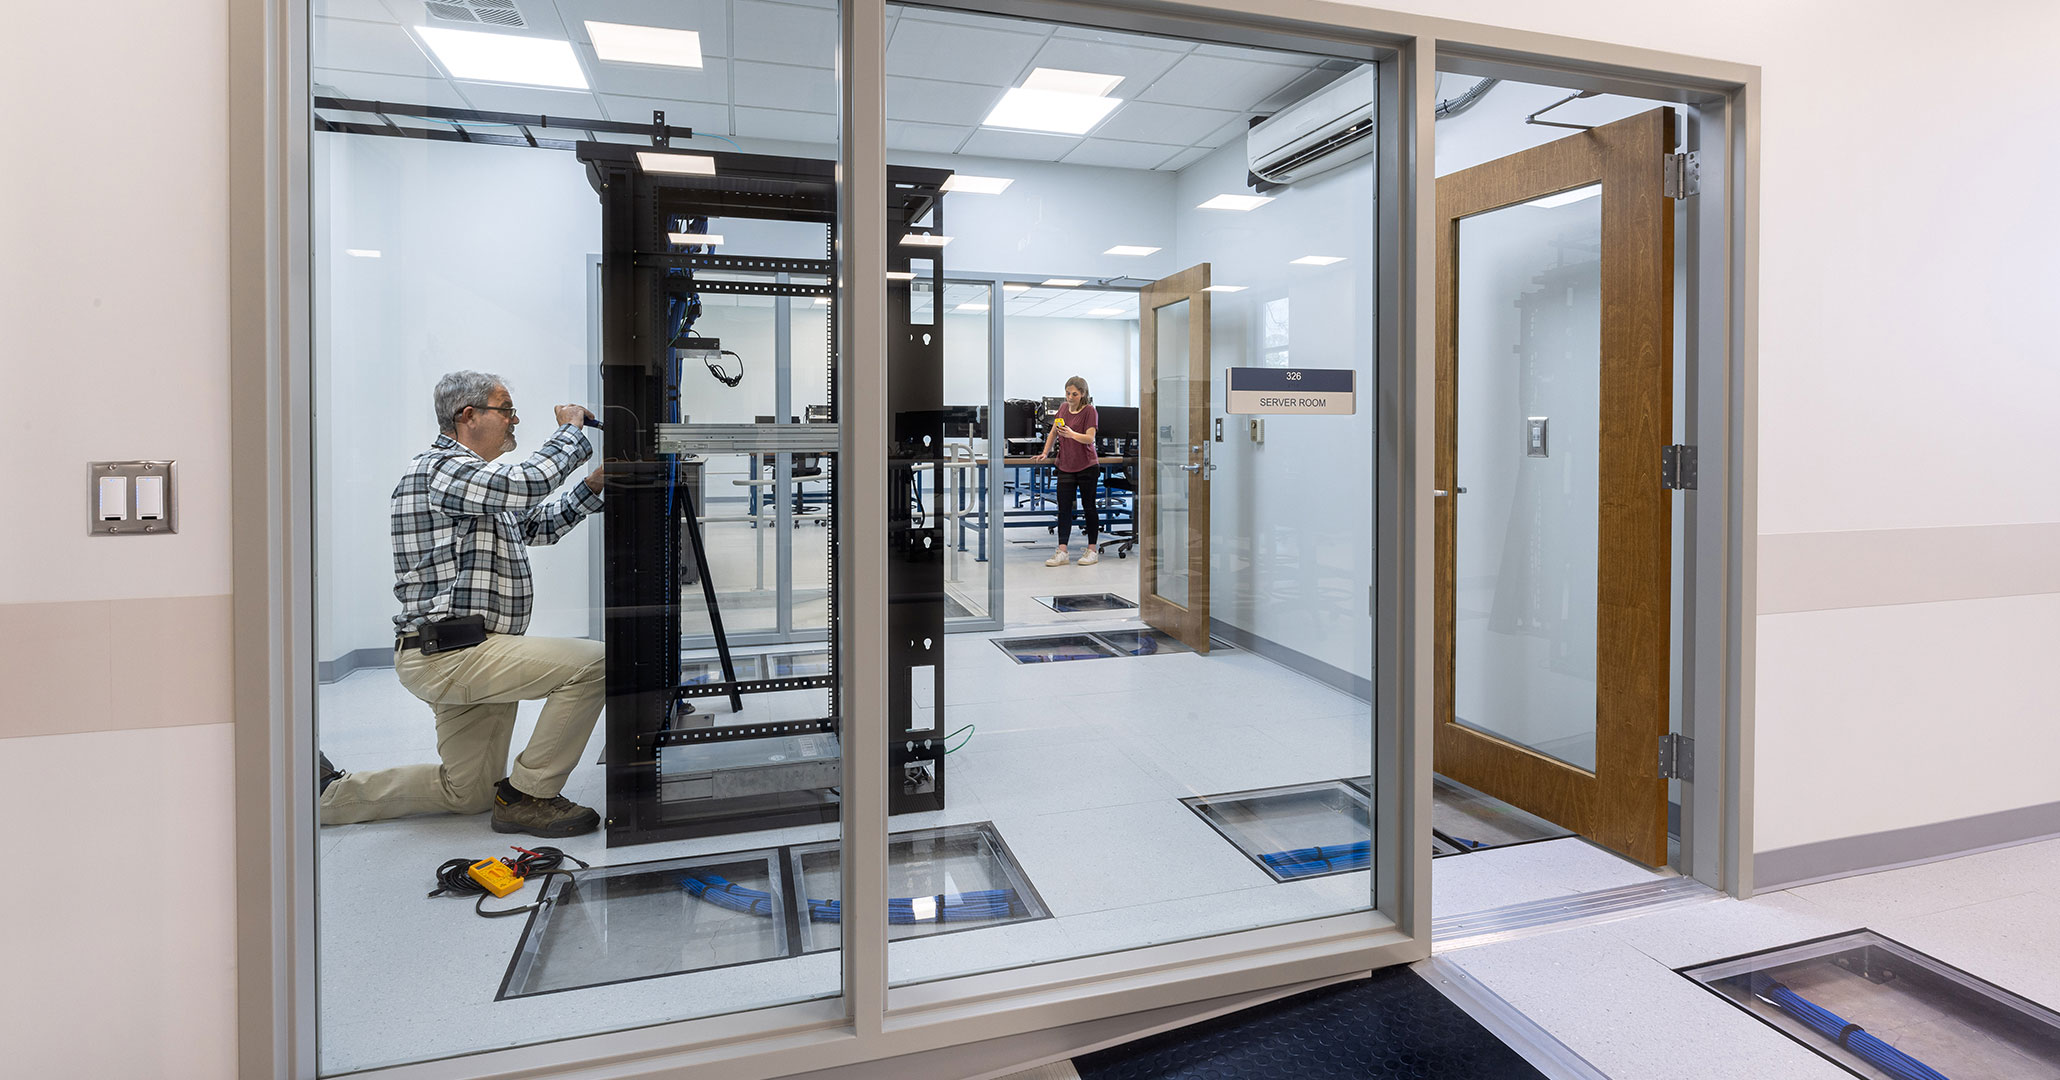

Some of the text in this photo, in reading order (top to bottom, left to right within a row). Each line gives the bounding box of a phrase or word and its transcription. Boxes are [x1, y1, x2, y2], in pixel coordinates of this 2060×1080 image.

[1286, 371, 1302, 381] 326
[1260, 398, 1326, 407] SERVER ROOM
